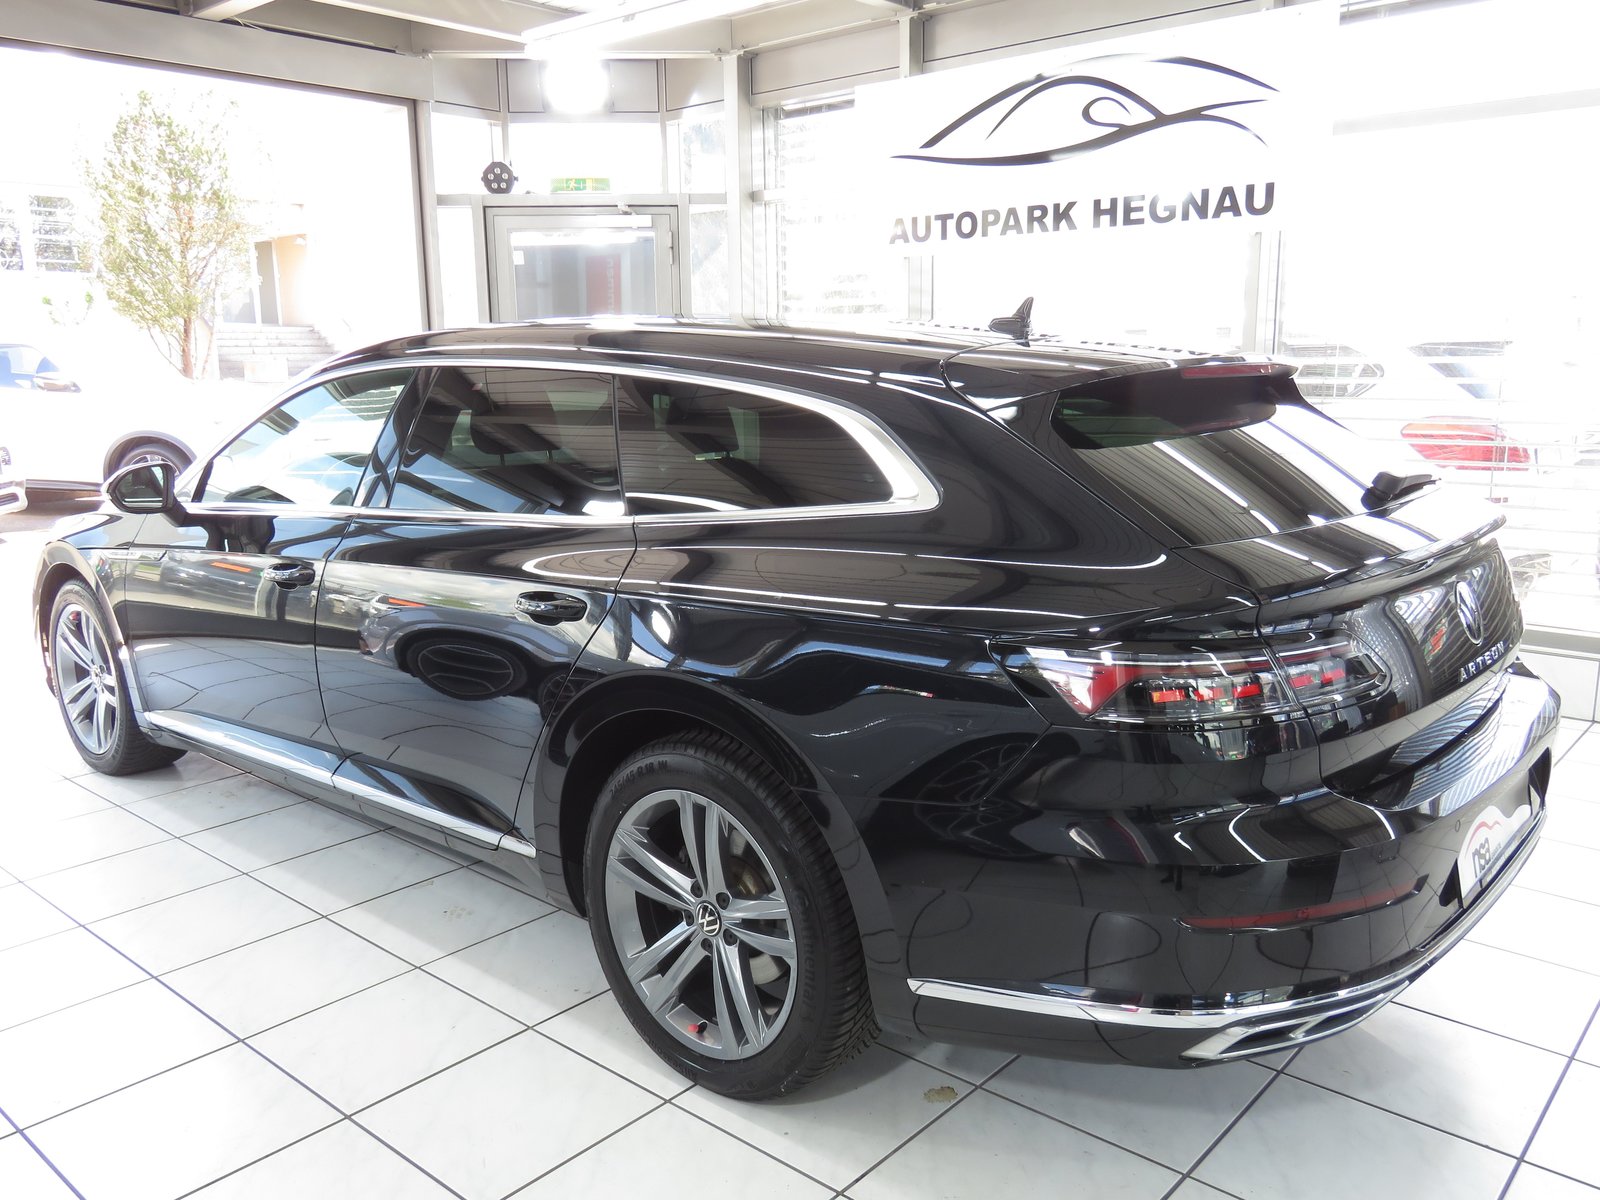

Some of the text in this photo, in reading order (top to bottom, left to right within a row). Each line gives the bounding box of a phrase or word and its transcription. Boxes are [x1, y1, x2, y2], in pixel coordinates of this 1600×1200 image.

[889, 182, 1275, 244] AUTOPARK HEGNAU
[1460, 641, 1505, 682] ARTEON
